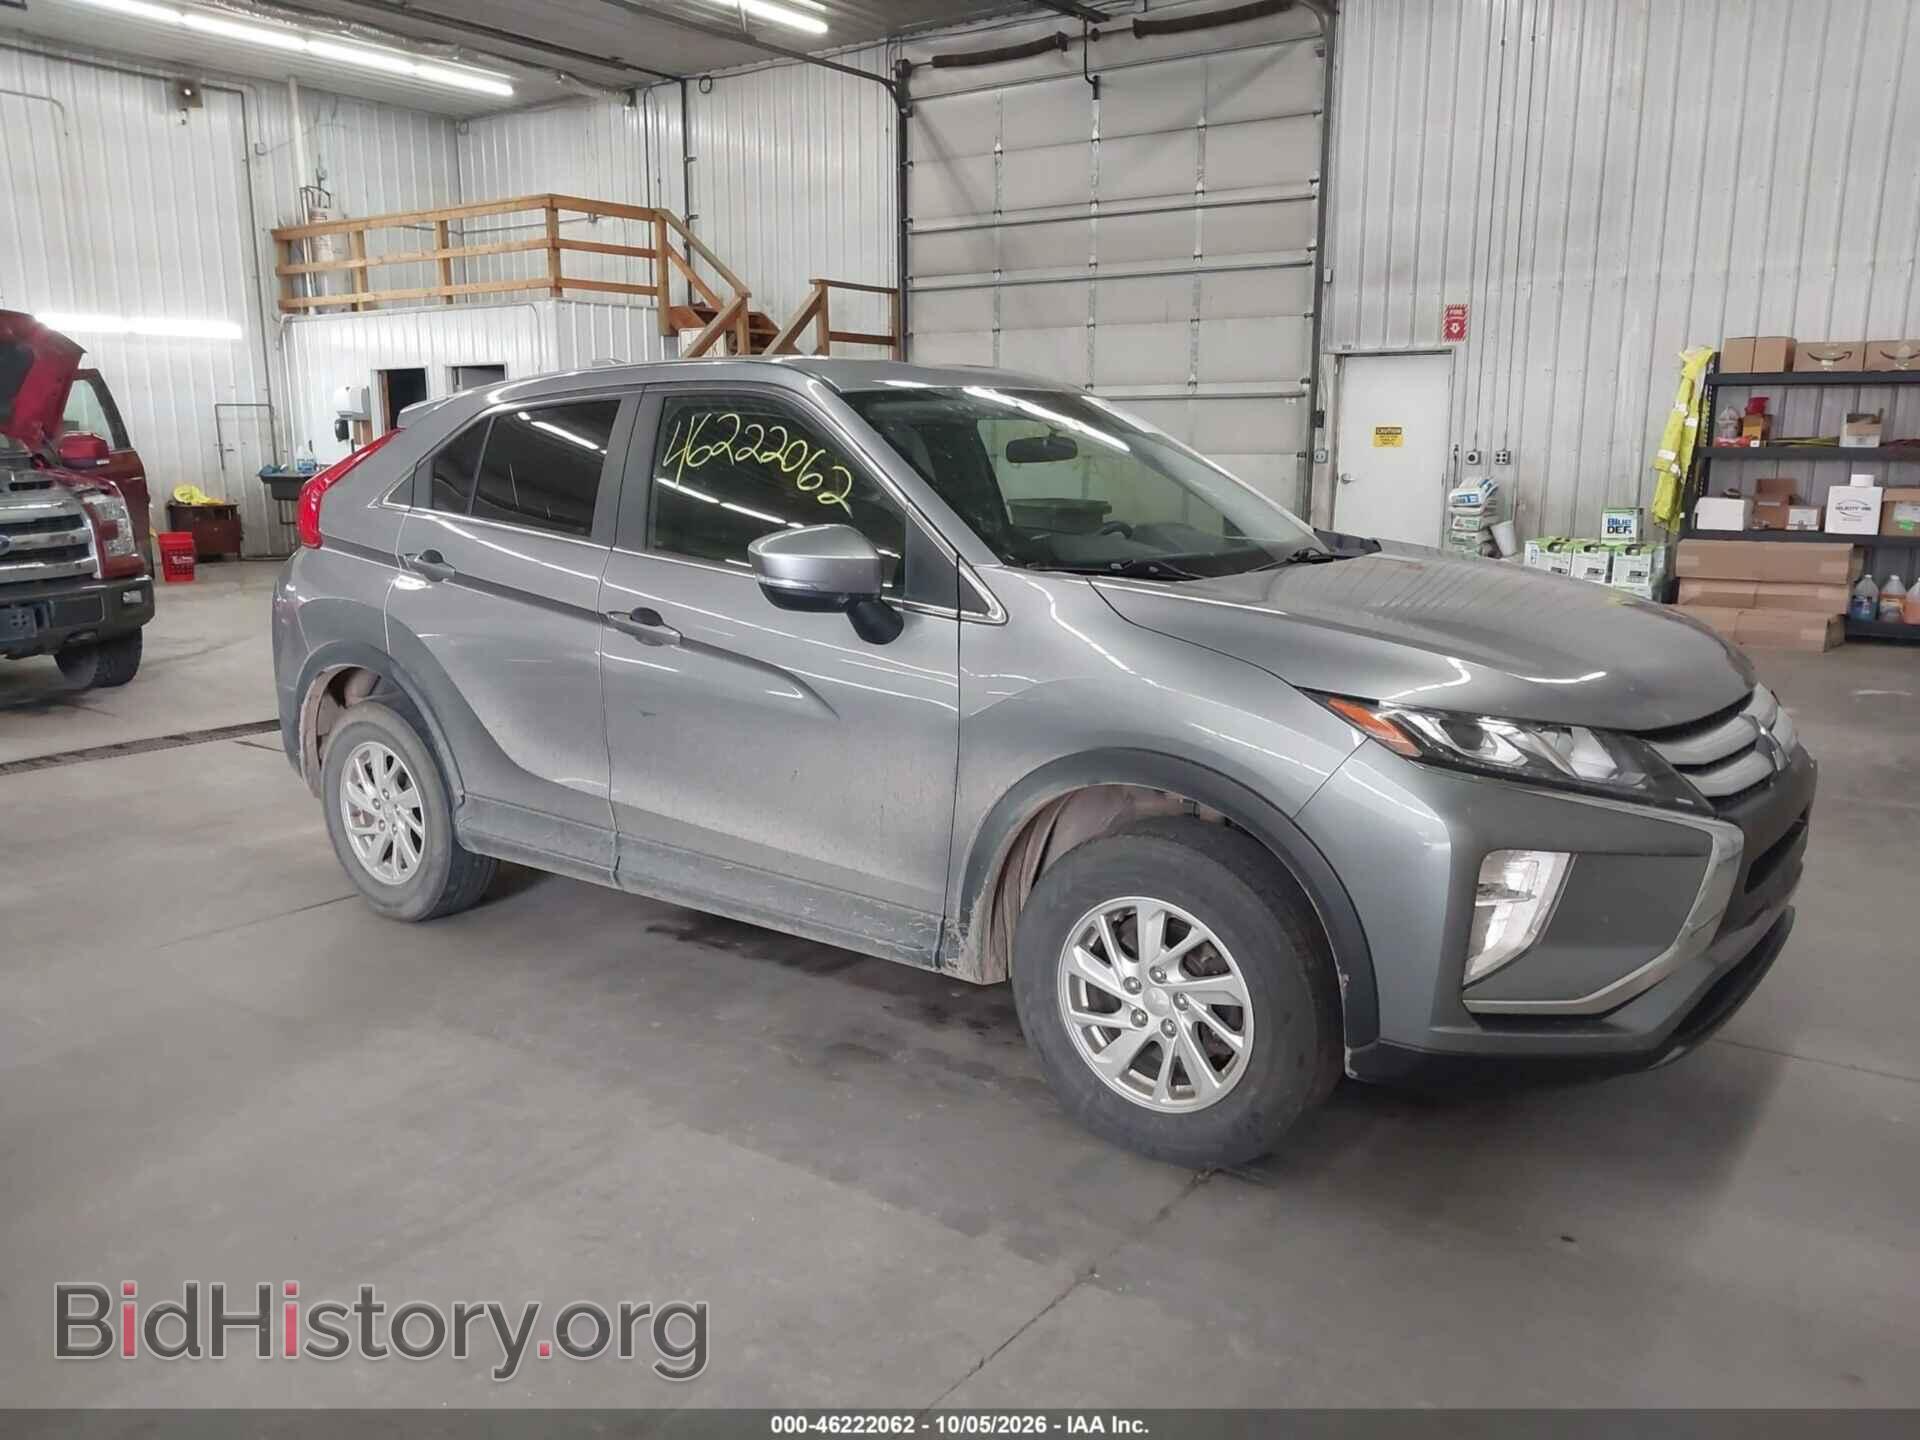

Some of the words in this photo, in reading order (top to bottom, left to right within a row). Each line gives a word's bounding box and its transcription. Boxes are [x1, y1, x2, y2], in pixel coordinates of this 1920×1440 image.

[662, 413, 854, 519] 46222062
[1607, 518, 1632, 526] Blue
[1607, 526, 1632, 534] DEF
